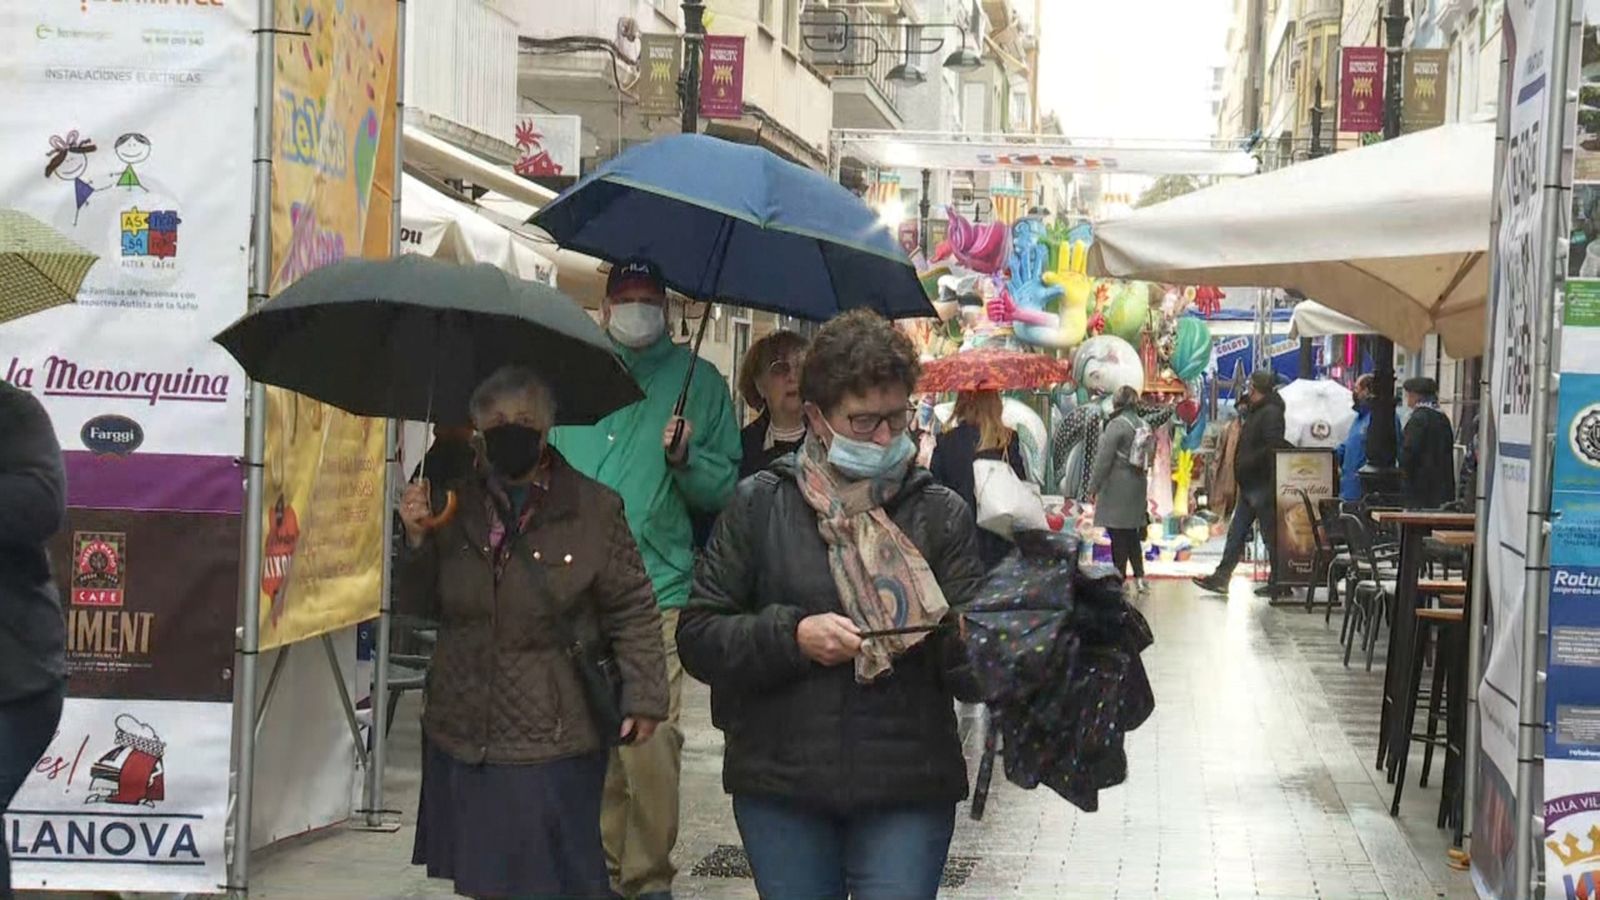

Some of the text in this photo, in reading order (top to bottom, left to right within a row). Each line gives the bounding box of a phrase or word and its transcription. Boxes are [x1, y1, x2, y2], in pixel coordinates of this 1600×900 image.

[45, 69, 132, 81] INSTALACIONES
[125, 217, 143, 227] AS
[90, 288, 125, 296] Familias
[127, 288, 136, 296] de
[140, 289, 178, 298] Personas
[6, 356, 229, 406] la Menorquina
[90, 427, 134, 442] Farggi
[1555, 570, 1600, 587] Rotu
[79, 591, 117, 602] CAFE
[68, 610, 155, 653] IMENT
